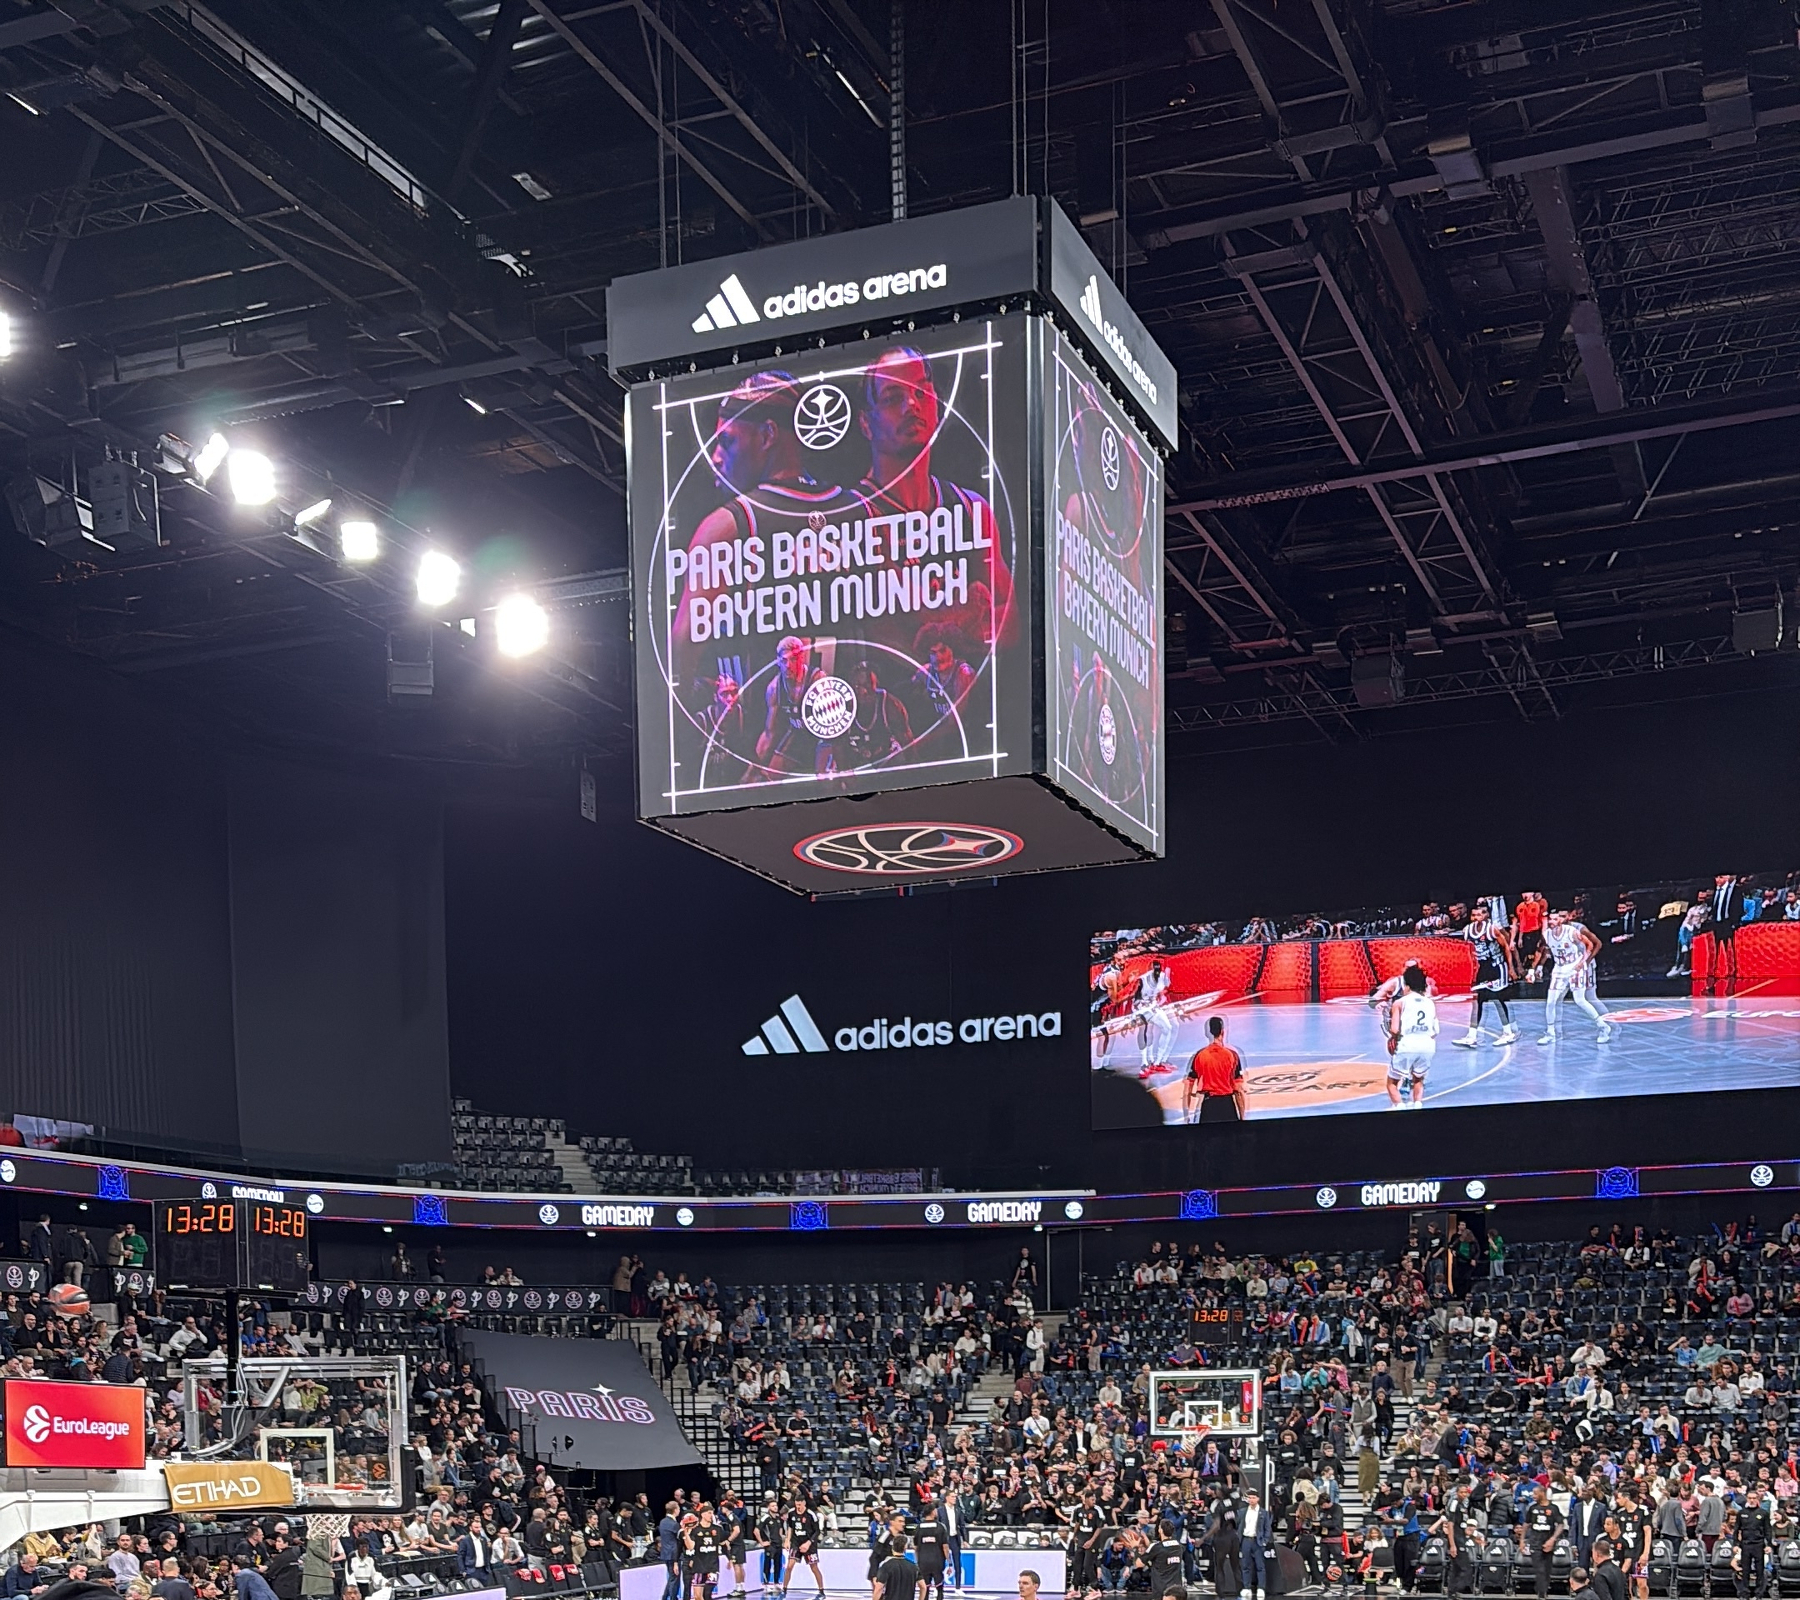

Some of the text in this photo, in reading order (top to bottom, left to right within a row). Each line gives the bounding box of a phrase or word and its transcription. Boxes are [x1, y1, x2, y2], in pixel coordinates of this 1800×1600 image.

[763, 264, 947, 319] adidas arena
[1104, 320, 1157, 405] adidas arena
[668, 501, 993, 596] PARIS BASKETBALL
[1056, 511, 1156, 649] PARIS BASKETBALL
[690, 557, 968, 643] BAYERN MUNICH
[1063, 571, 1149, 690] BAYERN MUNICH
[817, 680, 853, 702] BAYERN
[834, 1011, 1062, 1051] adidas arena
[1417, 1011, 1427, 1026] 2
[1361, 1182, 1441, 1206] GAMEDAY
[167, 1204, 235, 1234] 13:28
[254, 1206, 306, 1238] 13:28
[581, 1205, 655, 1226] GAMEDAY
[967, 1202, 1042, 1222] GAMEDAY
[1194, 1309, 1229, 1323] 13:28
[504, 1386, 657, 1425] PARIS
[53, 1416, 130, 1440] EuroLeague
[172, 1476, 262, 1505] ETIHAD
